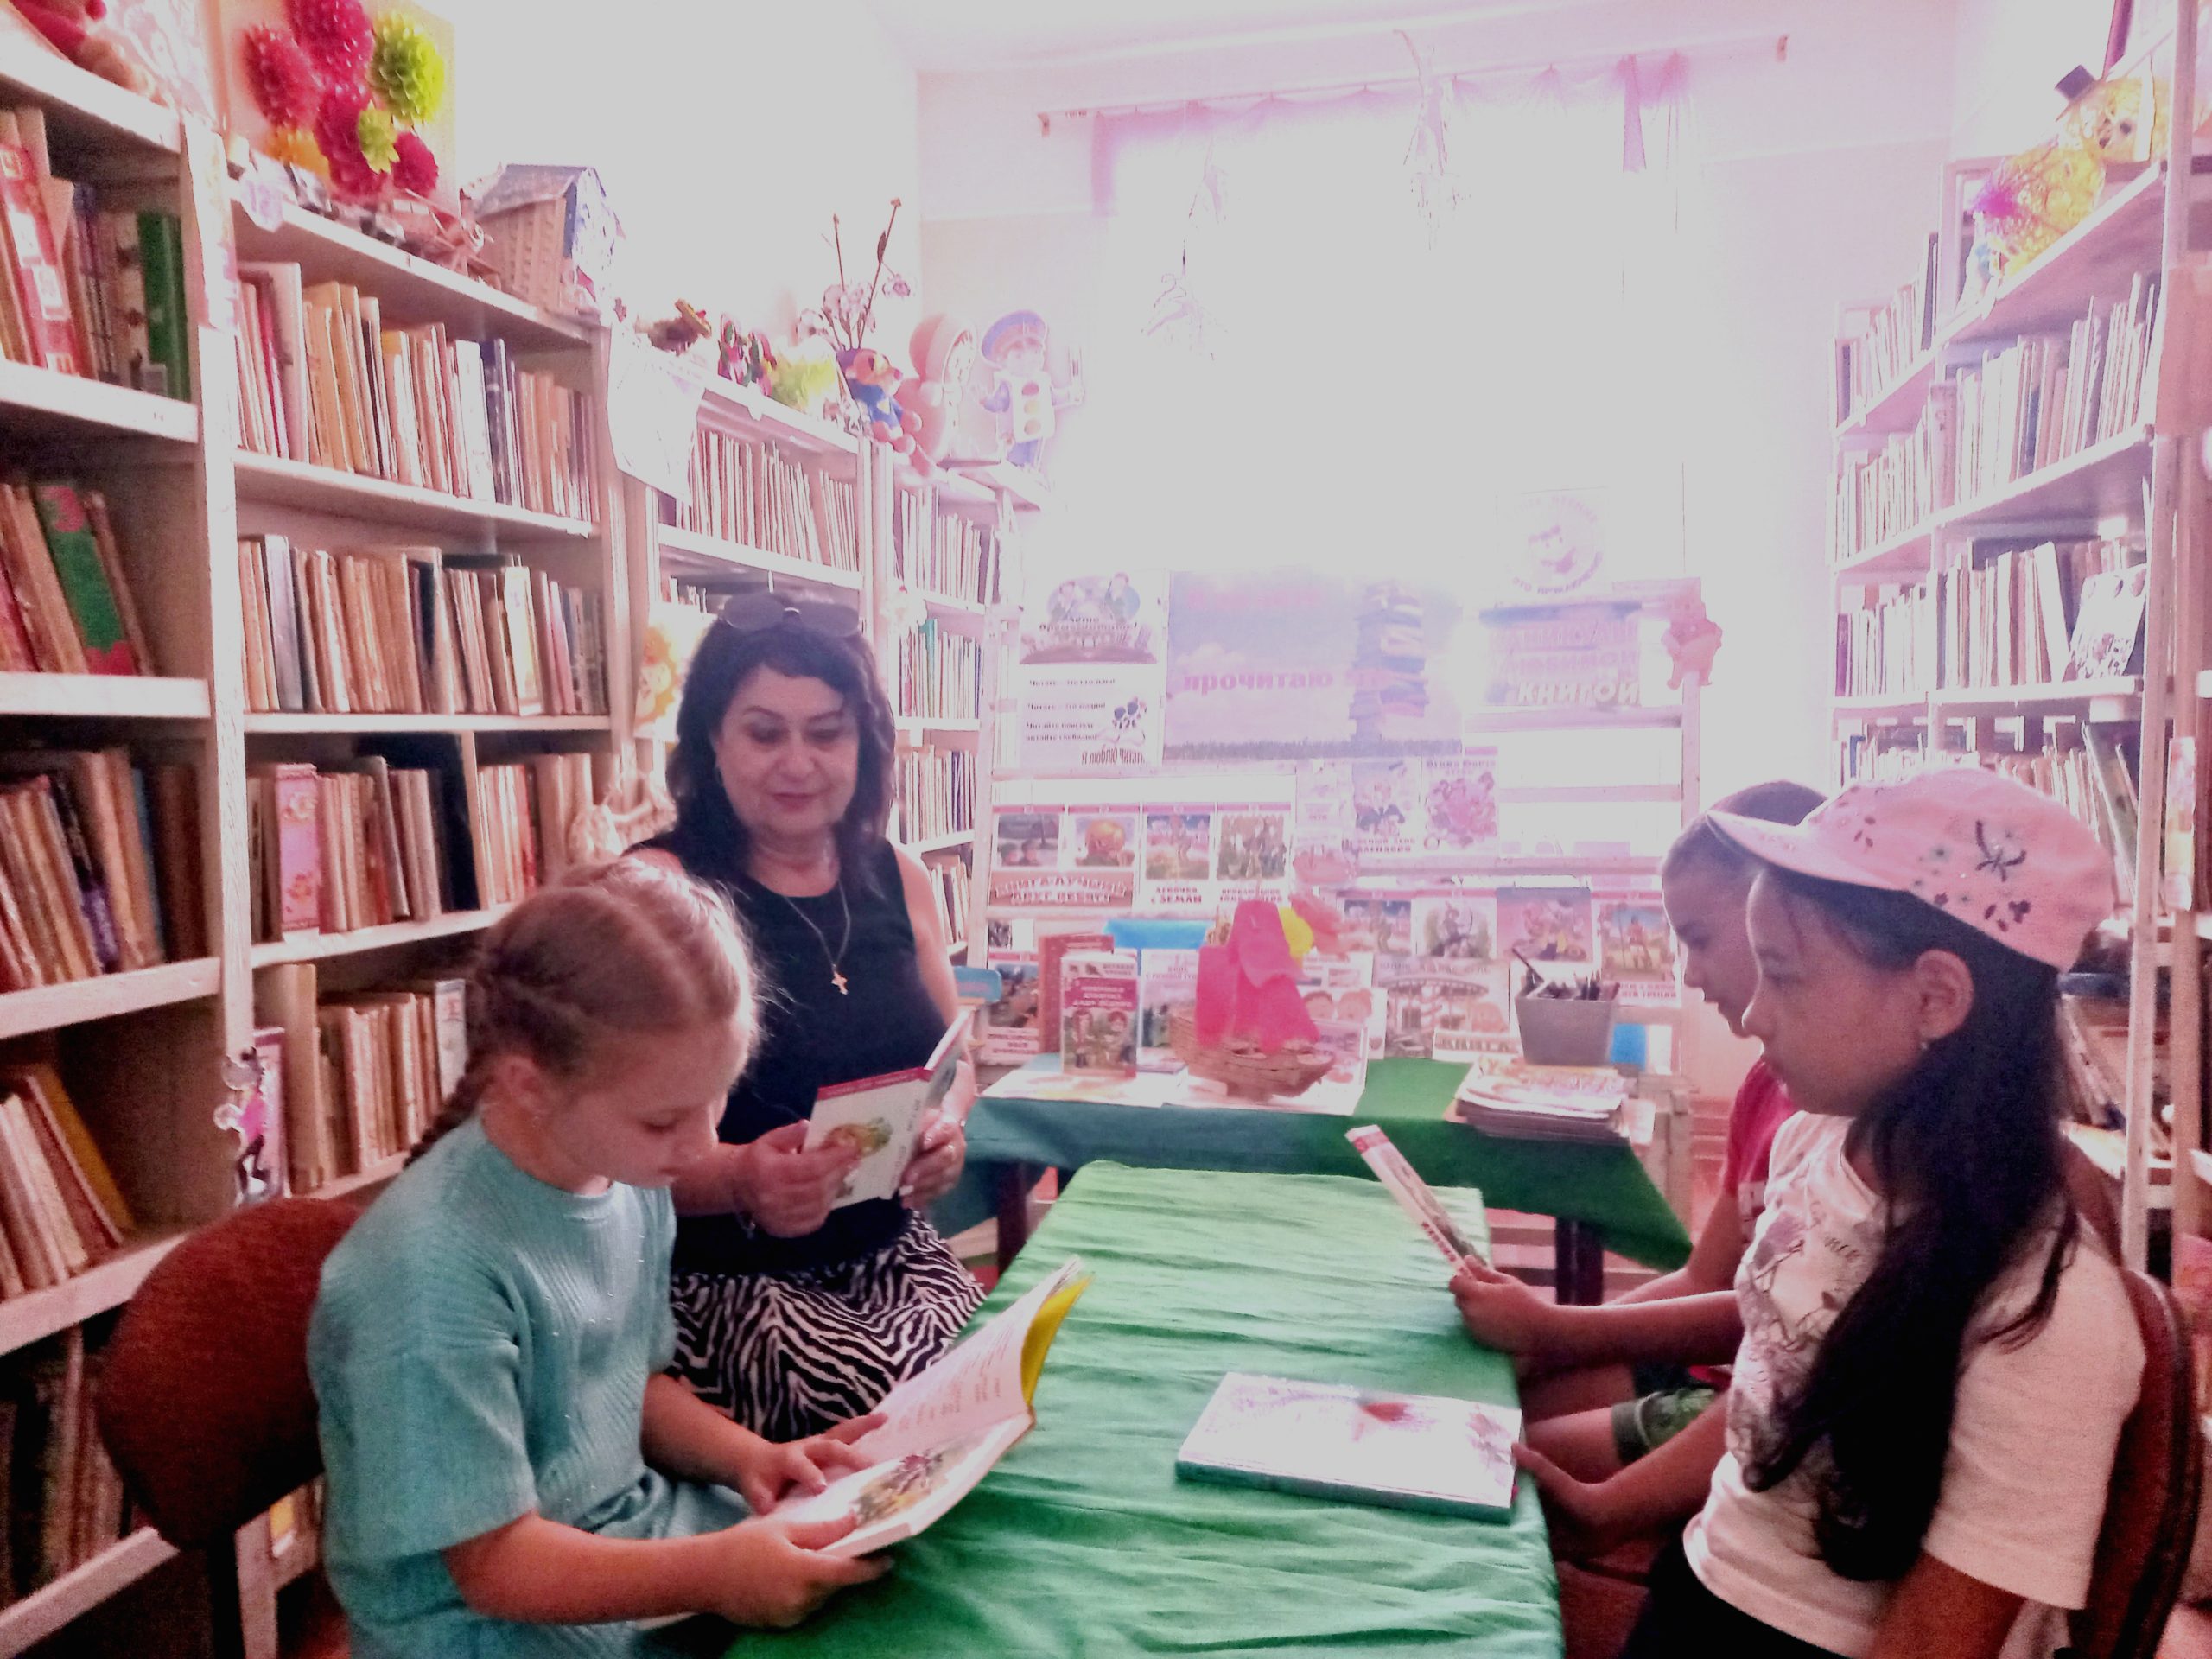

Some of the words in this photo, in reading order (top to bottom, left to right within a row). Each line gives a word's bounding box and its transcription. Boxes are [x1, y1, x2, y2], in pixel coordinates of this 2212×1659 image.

[1184, 670, 1334, 696] прочитаю
[1518, 678, 1641, 707] КНИГОЙ
[1090, 745, 1118, 766] люблю
